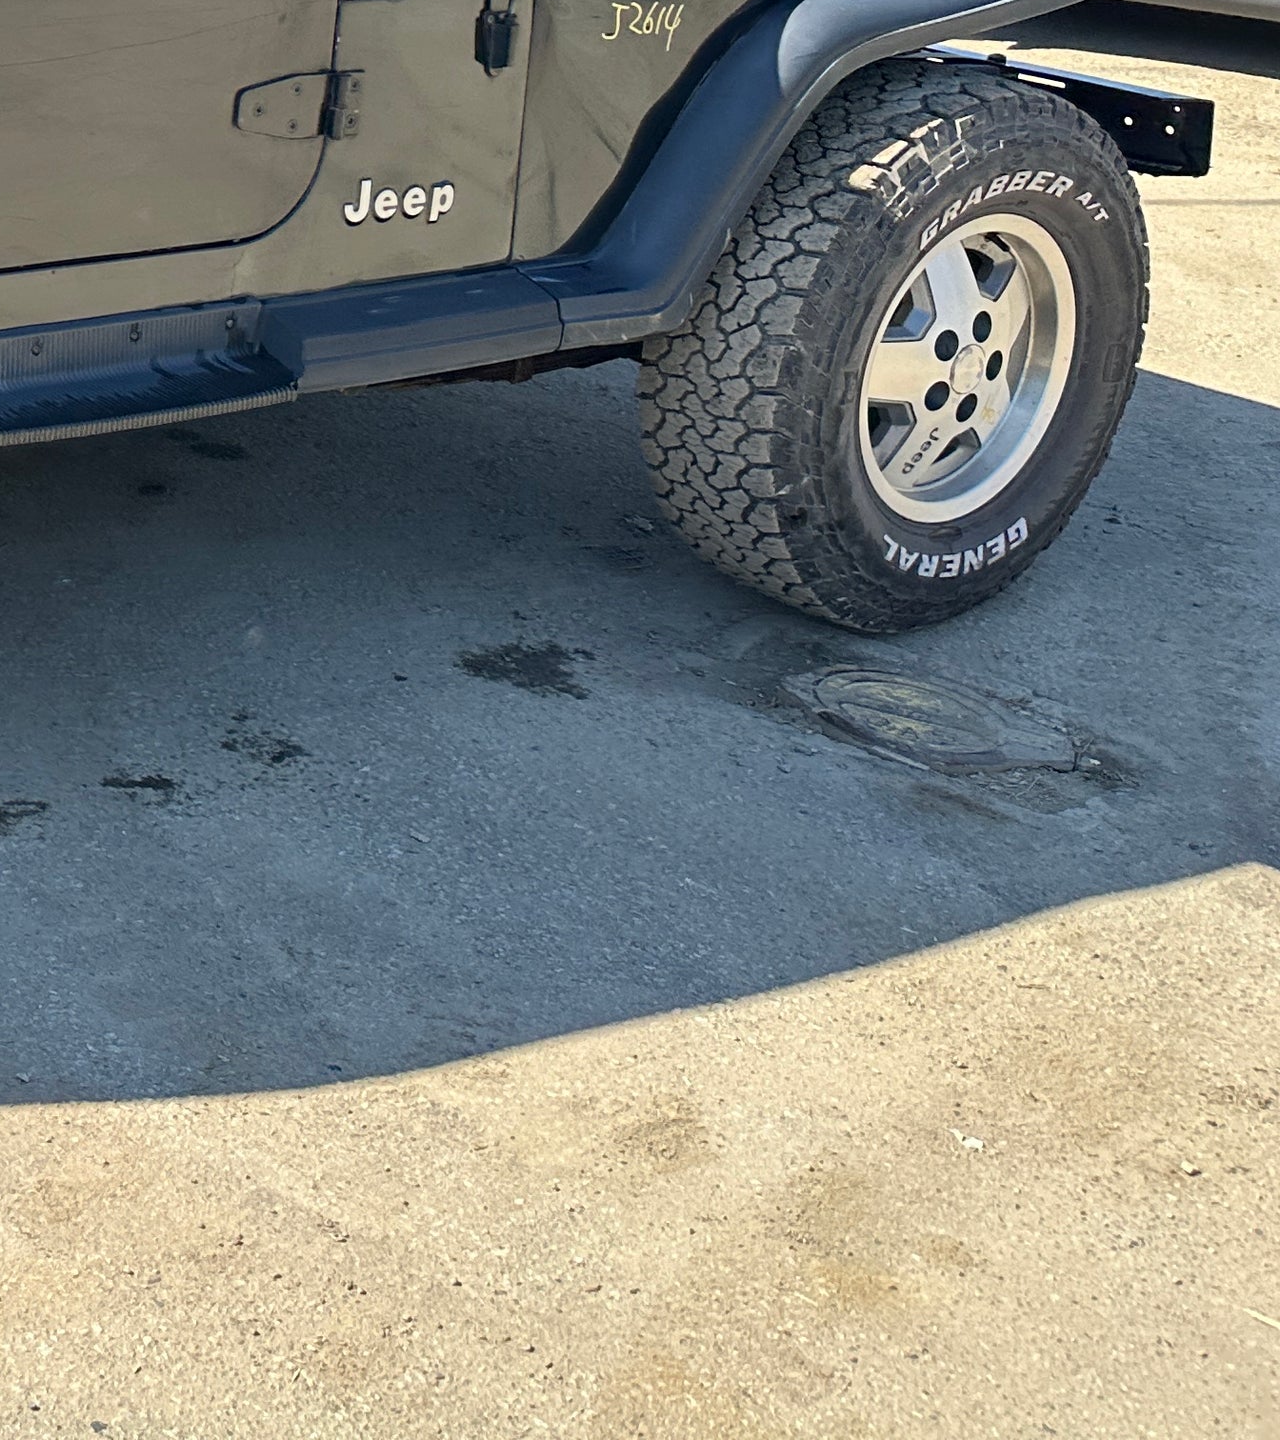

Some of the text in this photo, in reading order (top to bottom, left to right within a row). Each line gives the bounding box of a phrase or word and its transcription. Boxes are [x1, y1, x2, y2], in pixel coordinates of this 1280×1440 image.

[601, 1, 684, 51] J2614
[342, 178, 456, 226] Jeep
[919, 170, 1110, 250] GRABBER A/T
[901, 427, 939, 474] Jeep
[883, 517, 1029, 578] GENERAL
